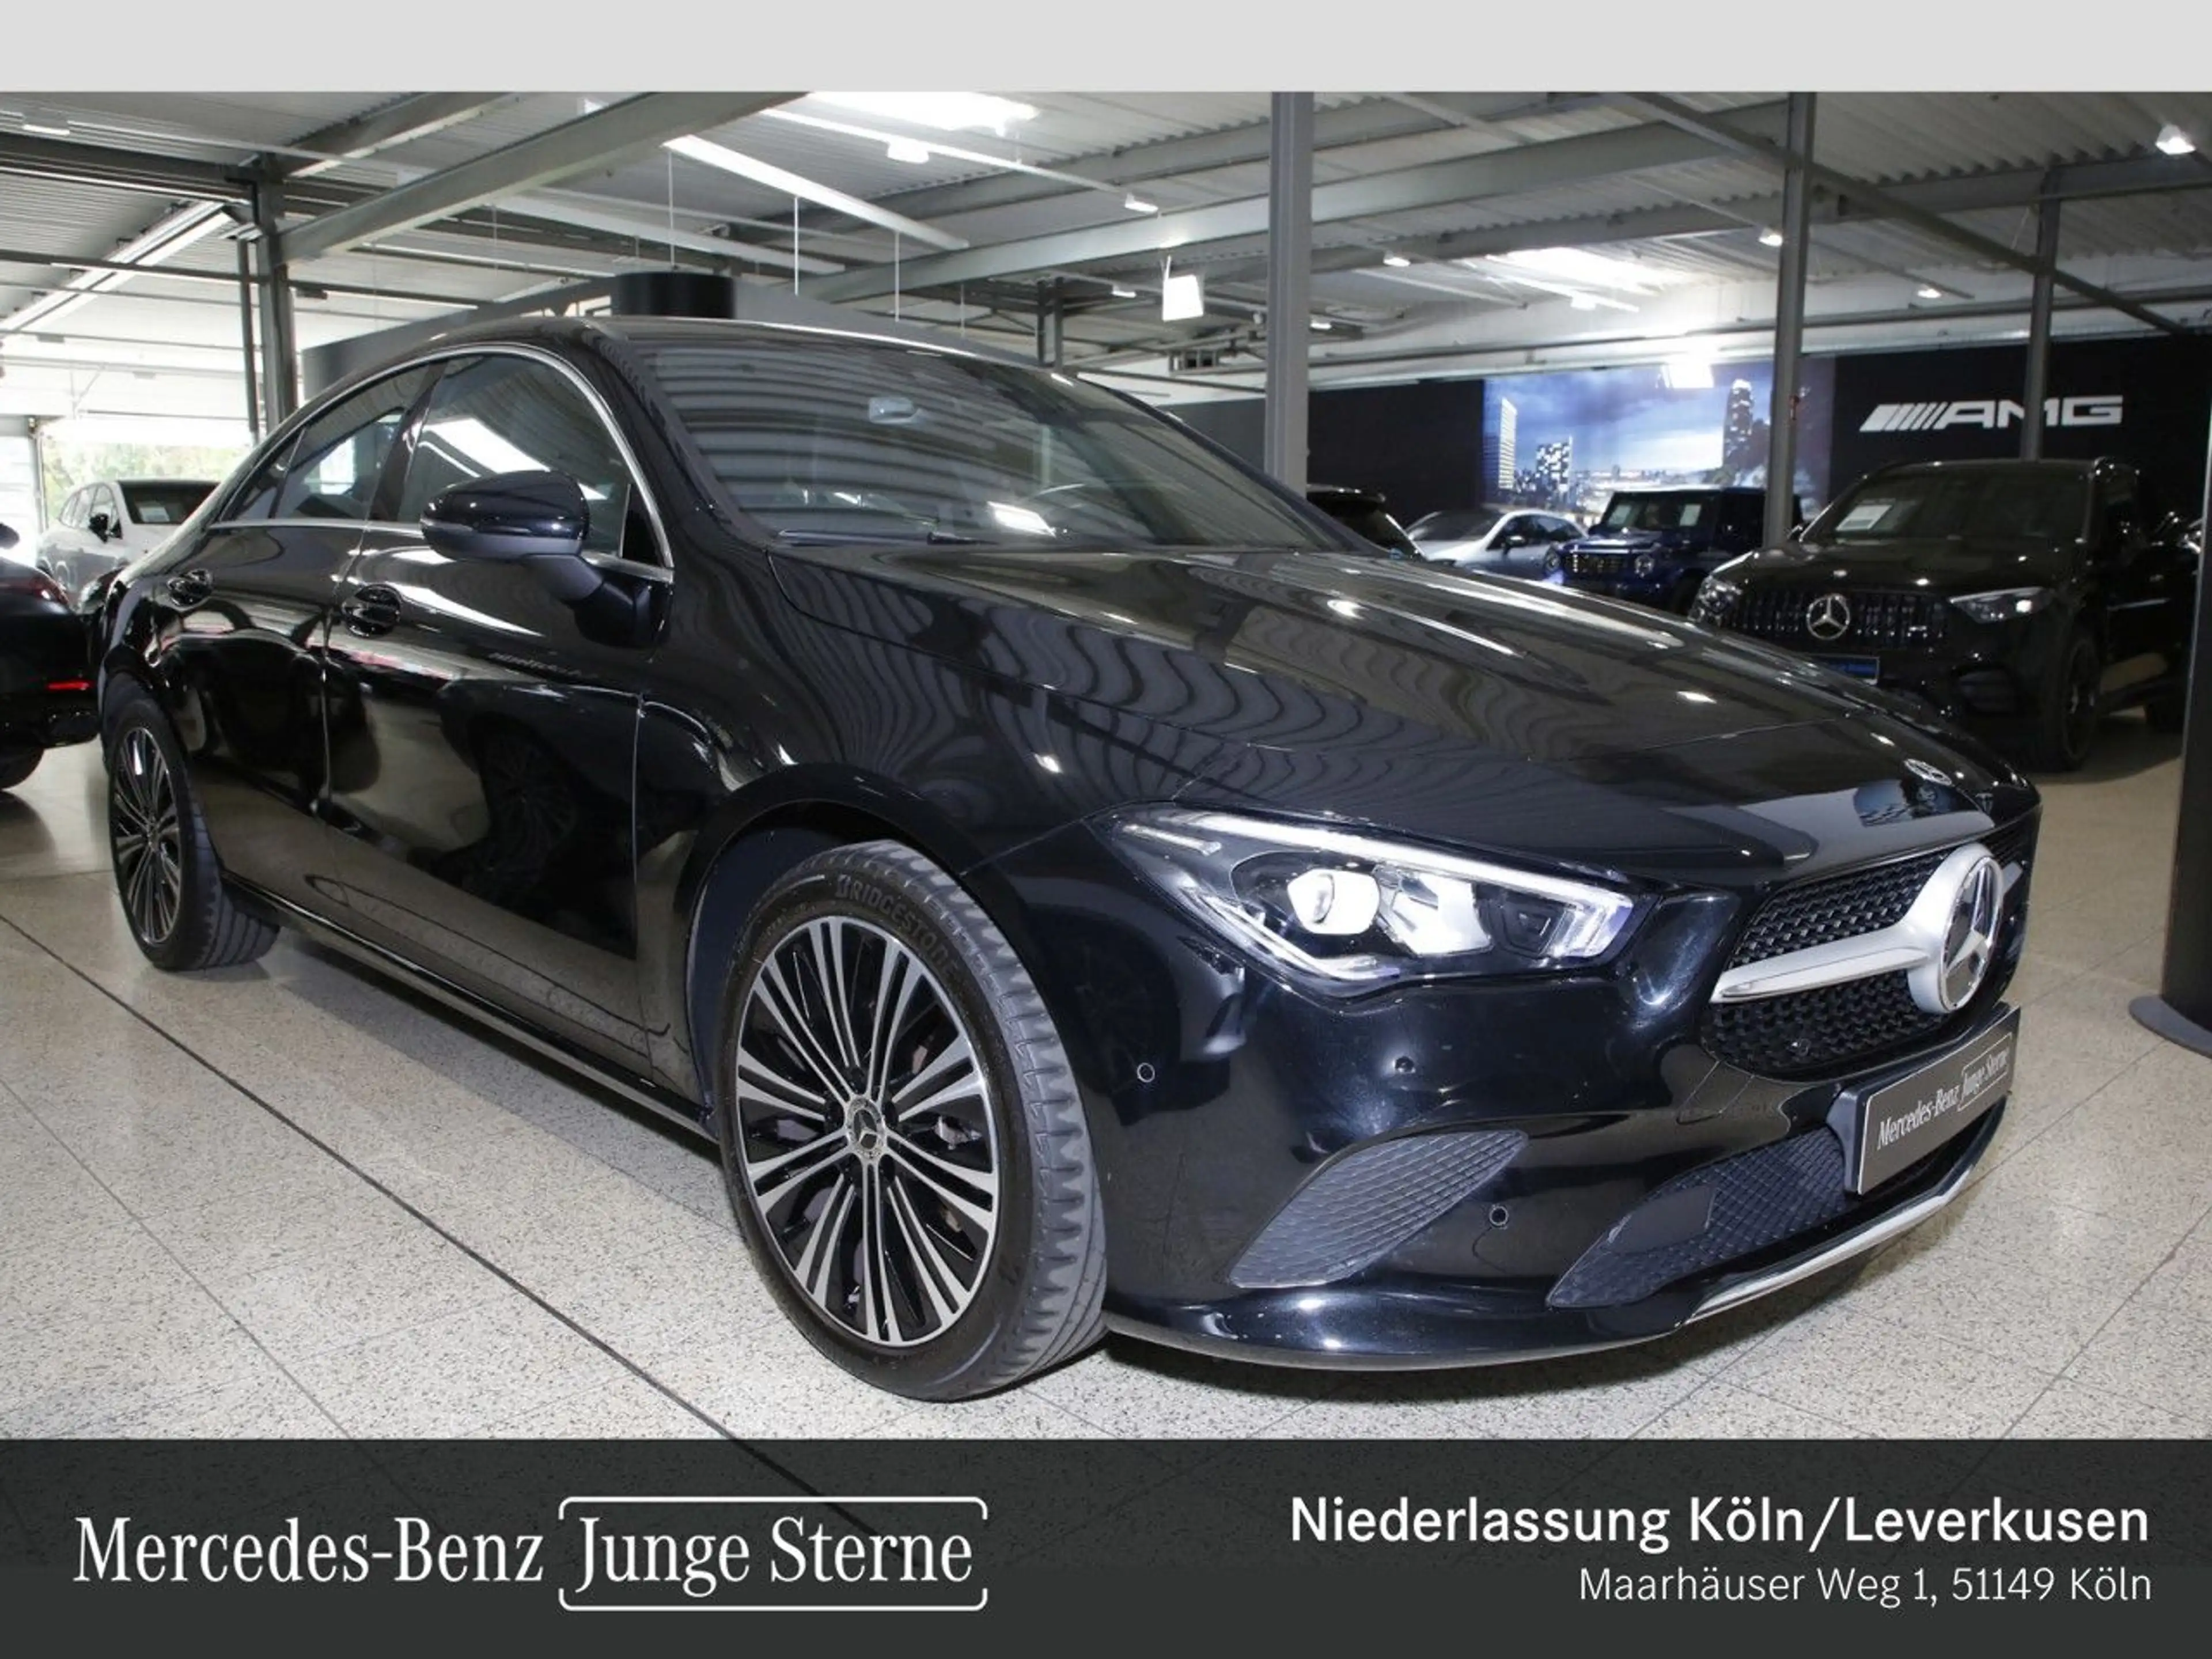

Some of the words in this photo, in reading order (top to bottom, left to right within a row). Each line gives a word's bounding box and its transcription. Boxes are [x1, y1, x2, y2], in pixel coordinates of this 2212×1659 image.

[1932, 395, 2123, 430] AMG
[834, 874, 959, 976] BRIDGESTONE
[1877, 1085, 1960, 1151] Mercedes-Benz
